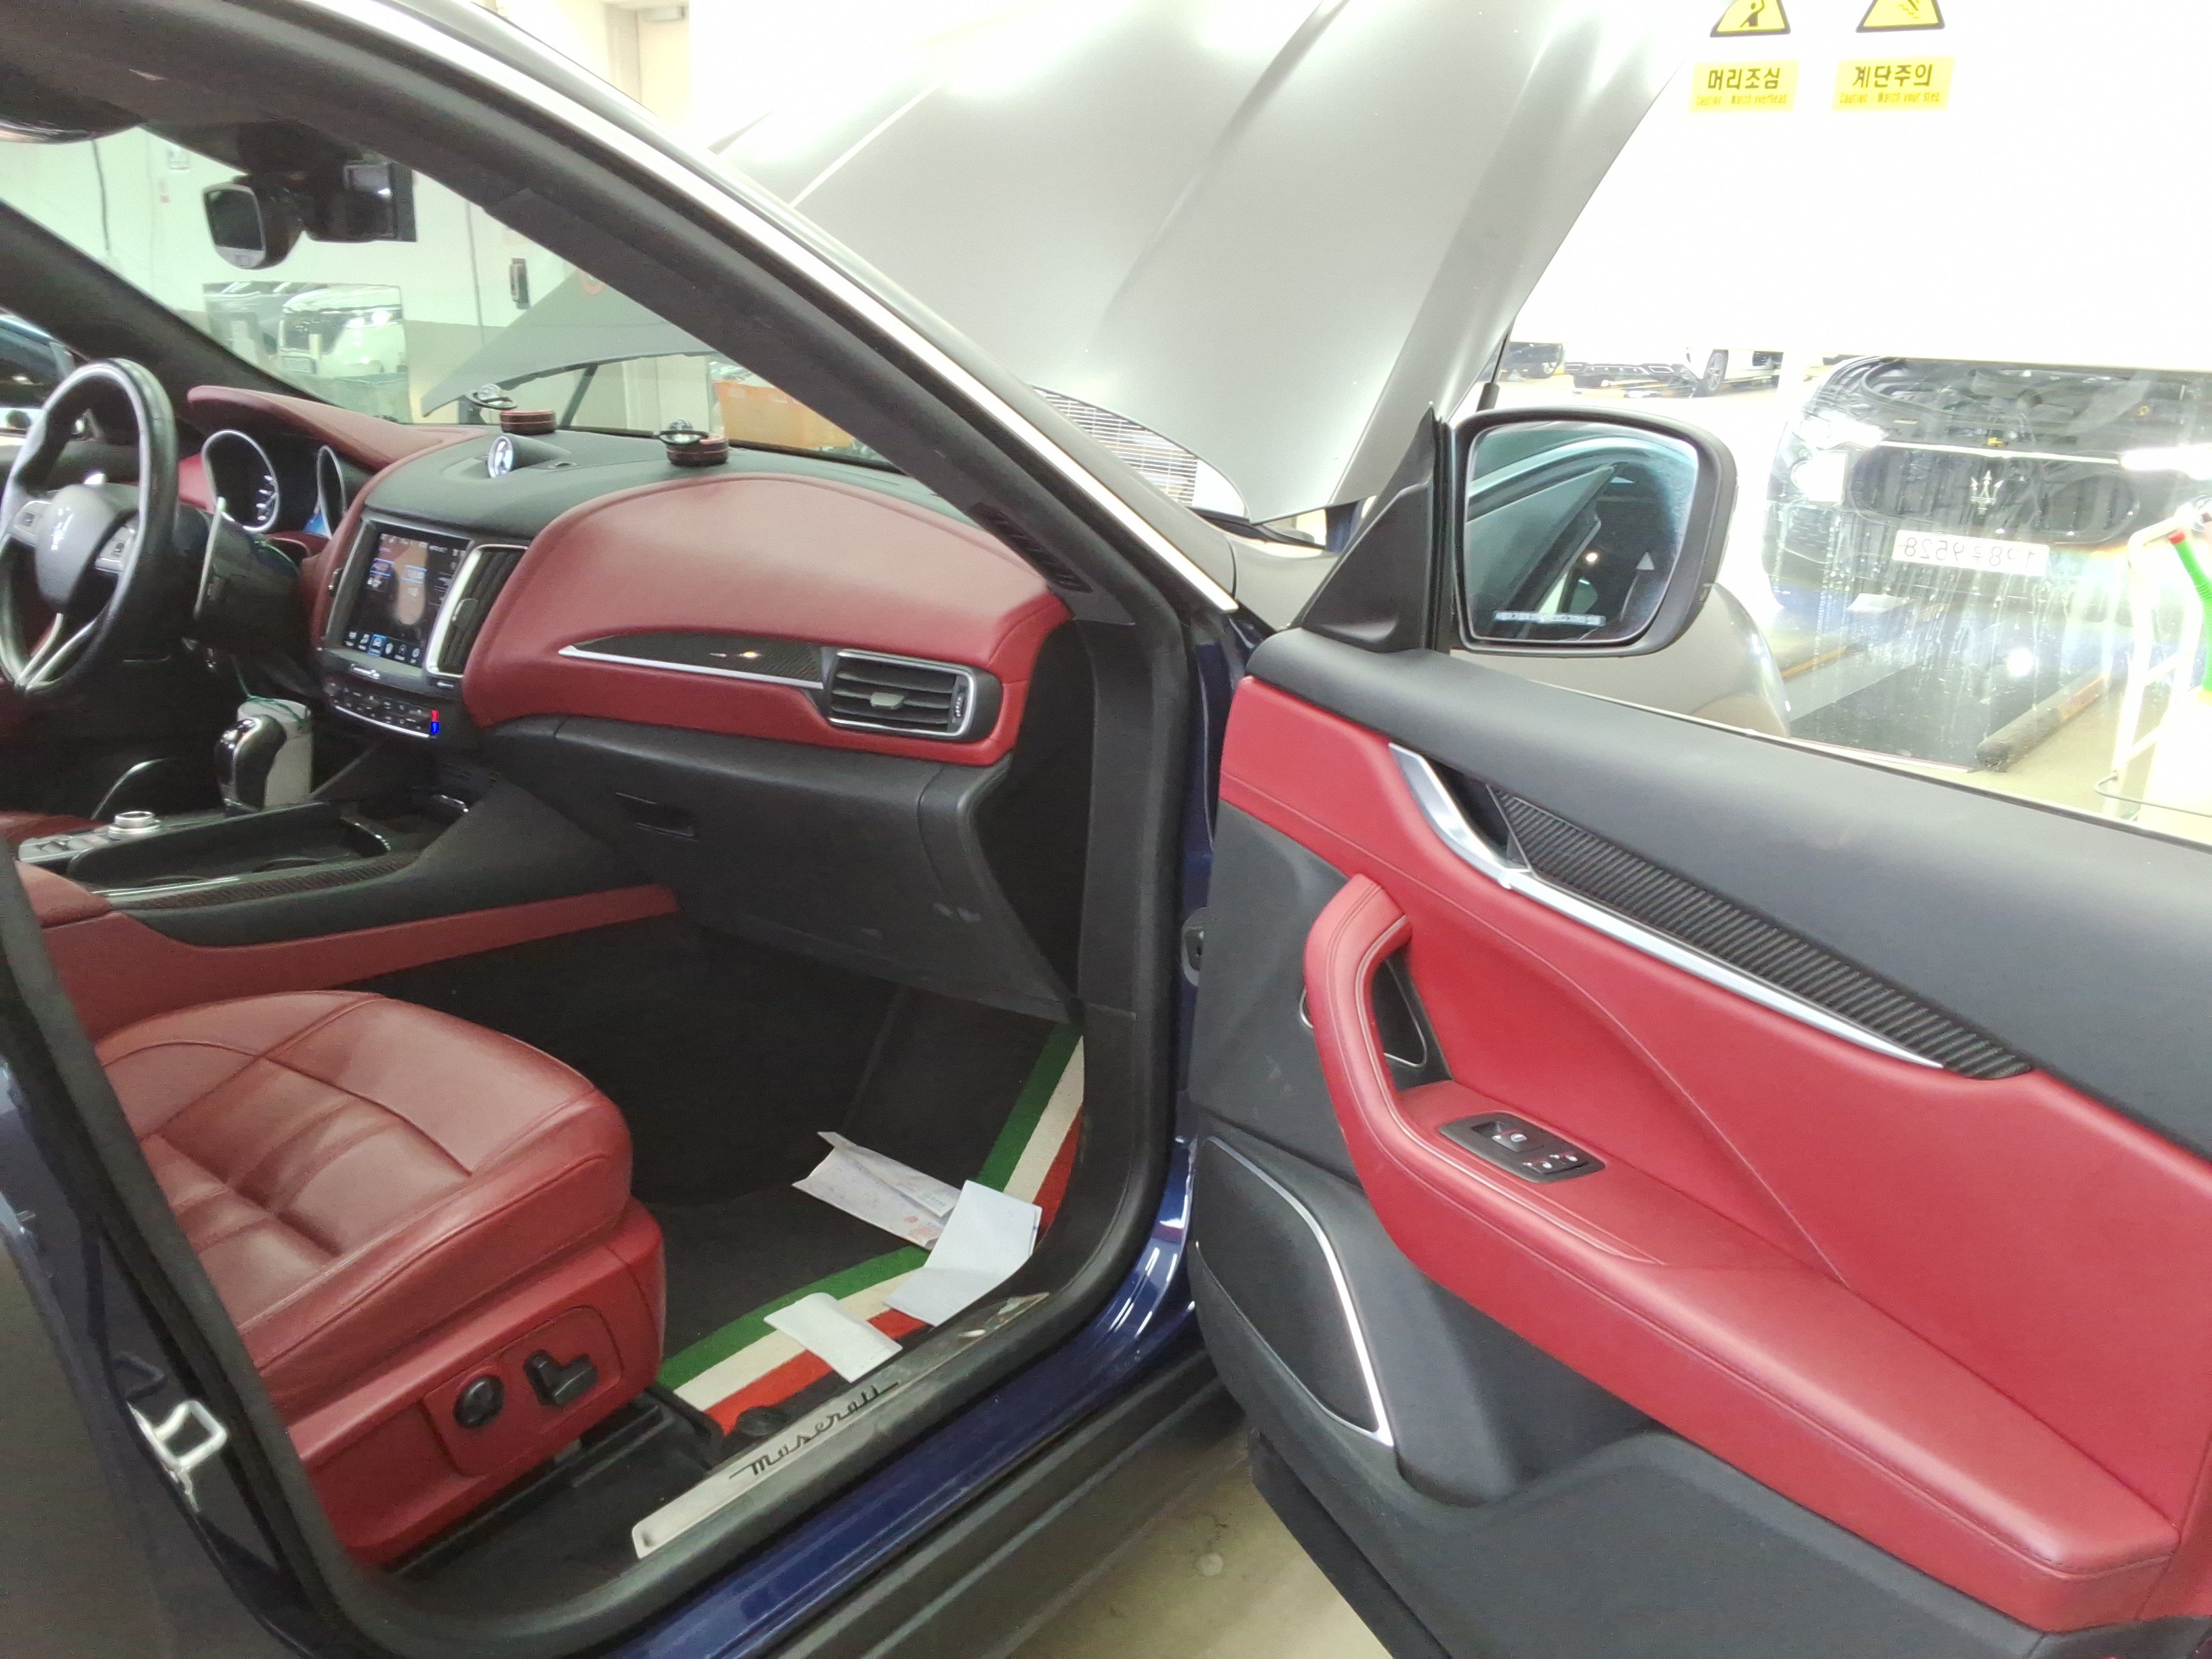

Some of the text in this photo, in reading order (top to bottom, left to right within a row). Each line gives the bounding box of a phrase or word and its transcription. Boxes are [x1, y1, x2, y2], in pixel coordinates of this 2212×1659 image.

[1707, 67, 1781, 91] 머리조심
[1852, 64, 1933, 88] 계단주의
[729, 1380, 901, 1479] Maserati
